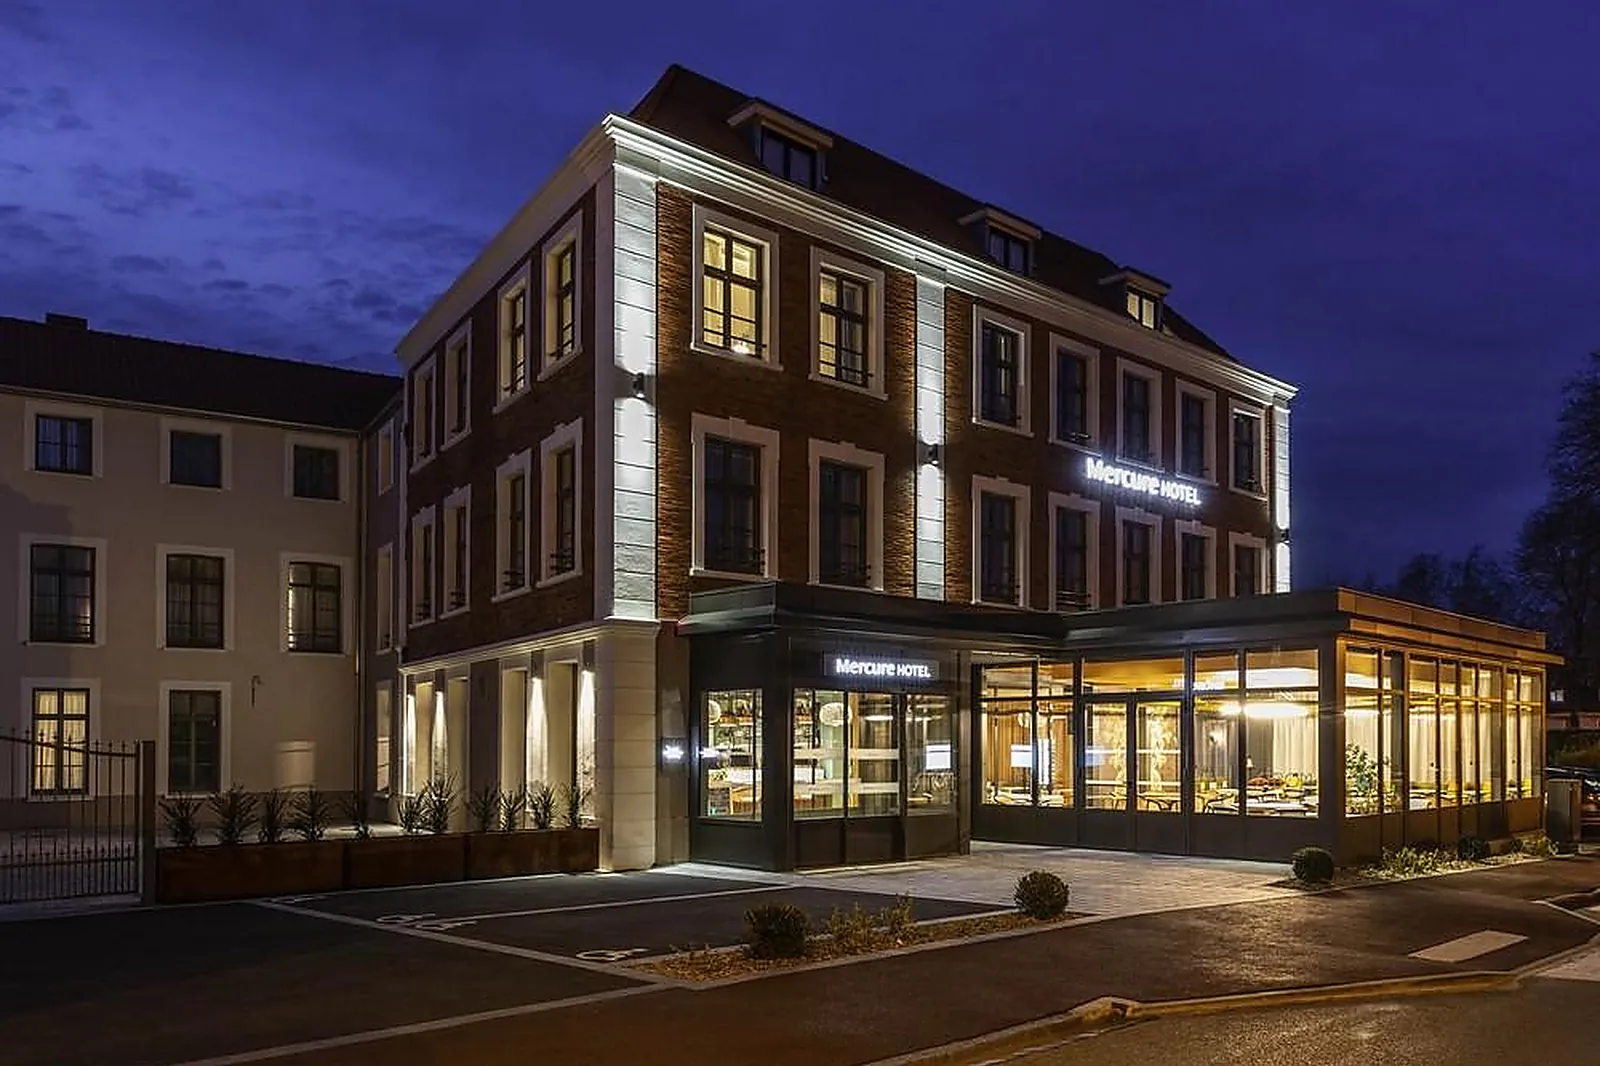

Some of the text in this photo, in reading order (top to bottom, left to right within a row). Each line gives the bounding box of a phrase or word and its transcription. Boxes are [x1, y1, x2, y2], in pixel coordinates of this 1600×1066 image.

[1086, 457, 1202, 505] Mercure HOTEL
[836, 659, 931, 678] Mercure HOTEL
